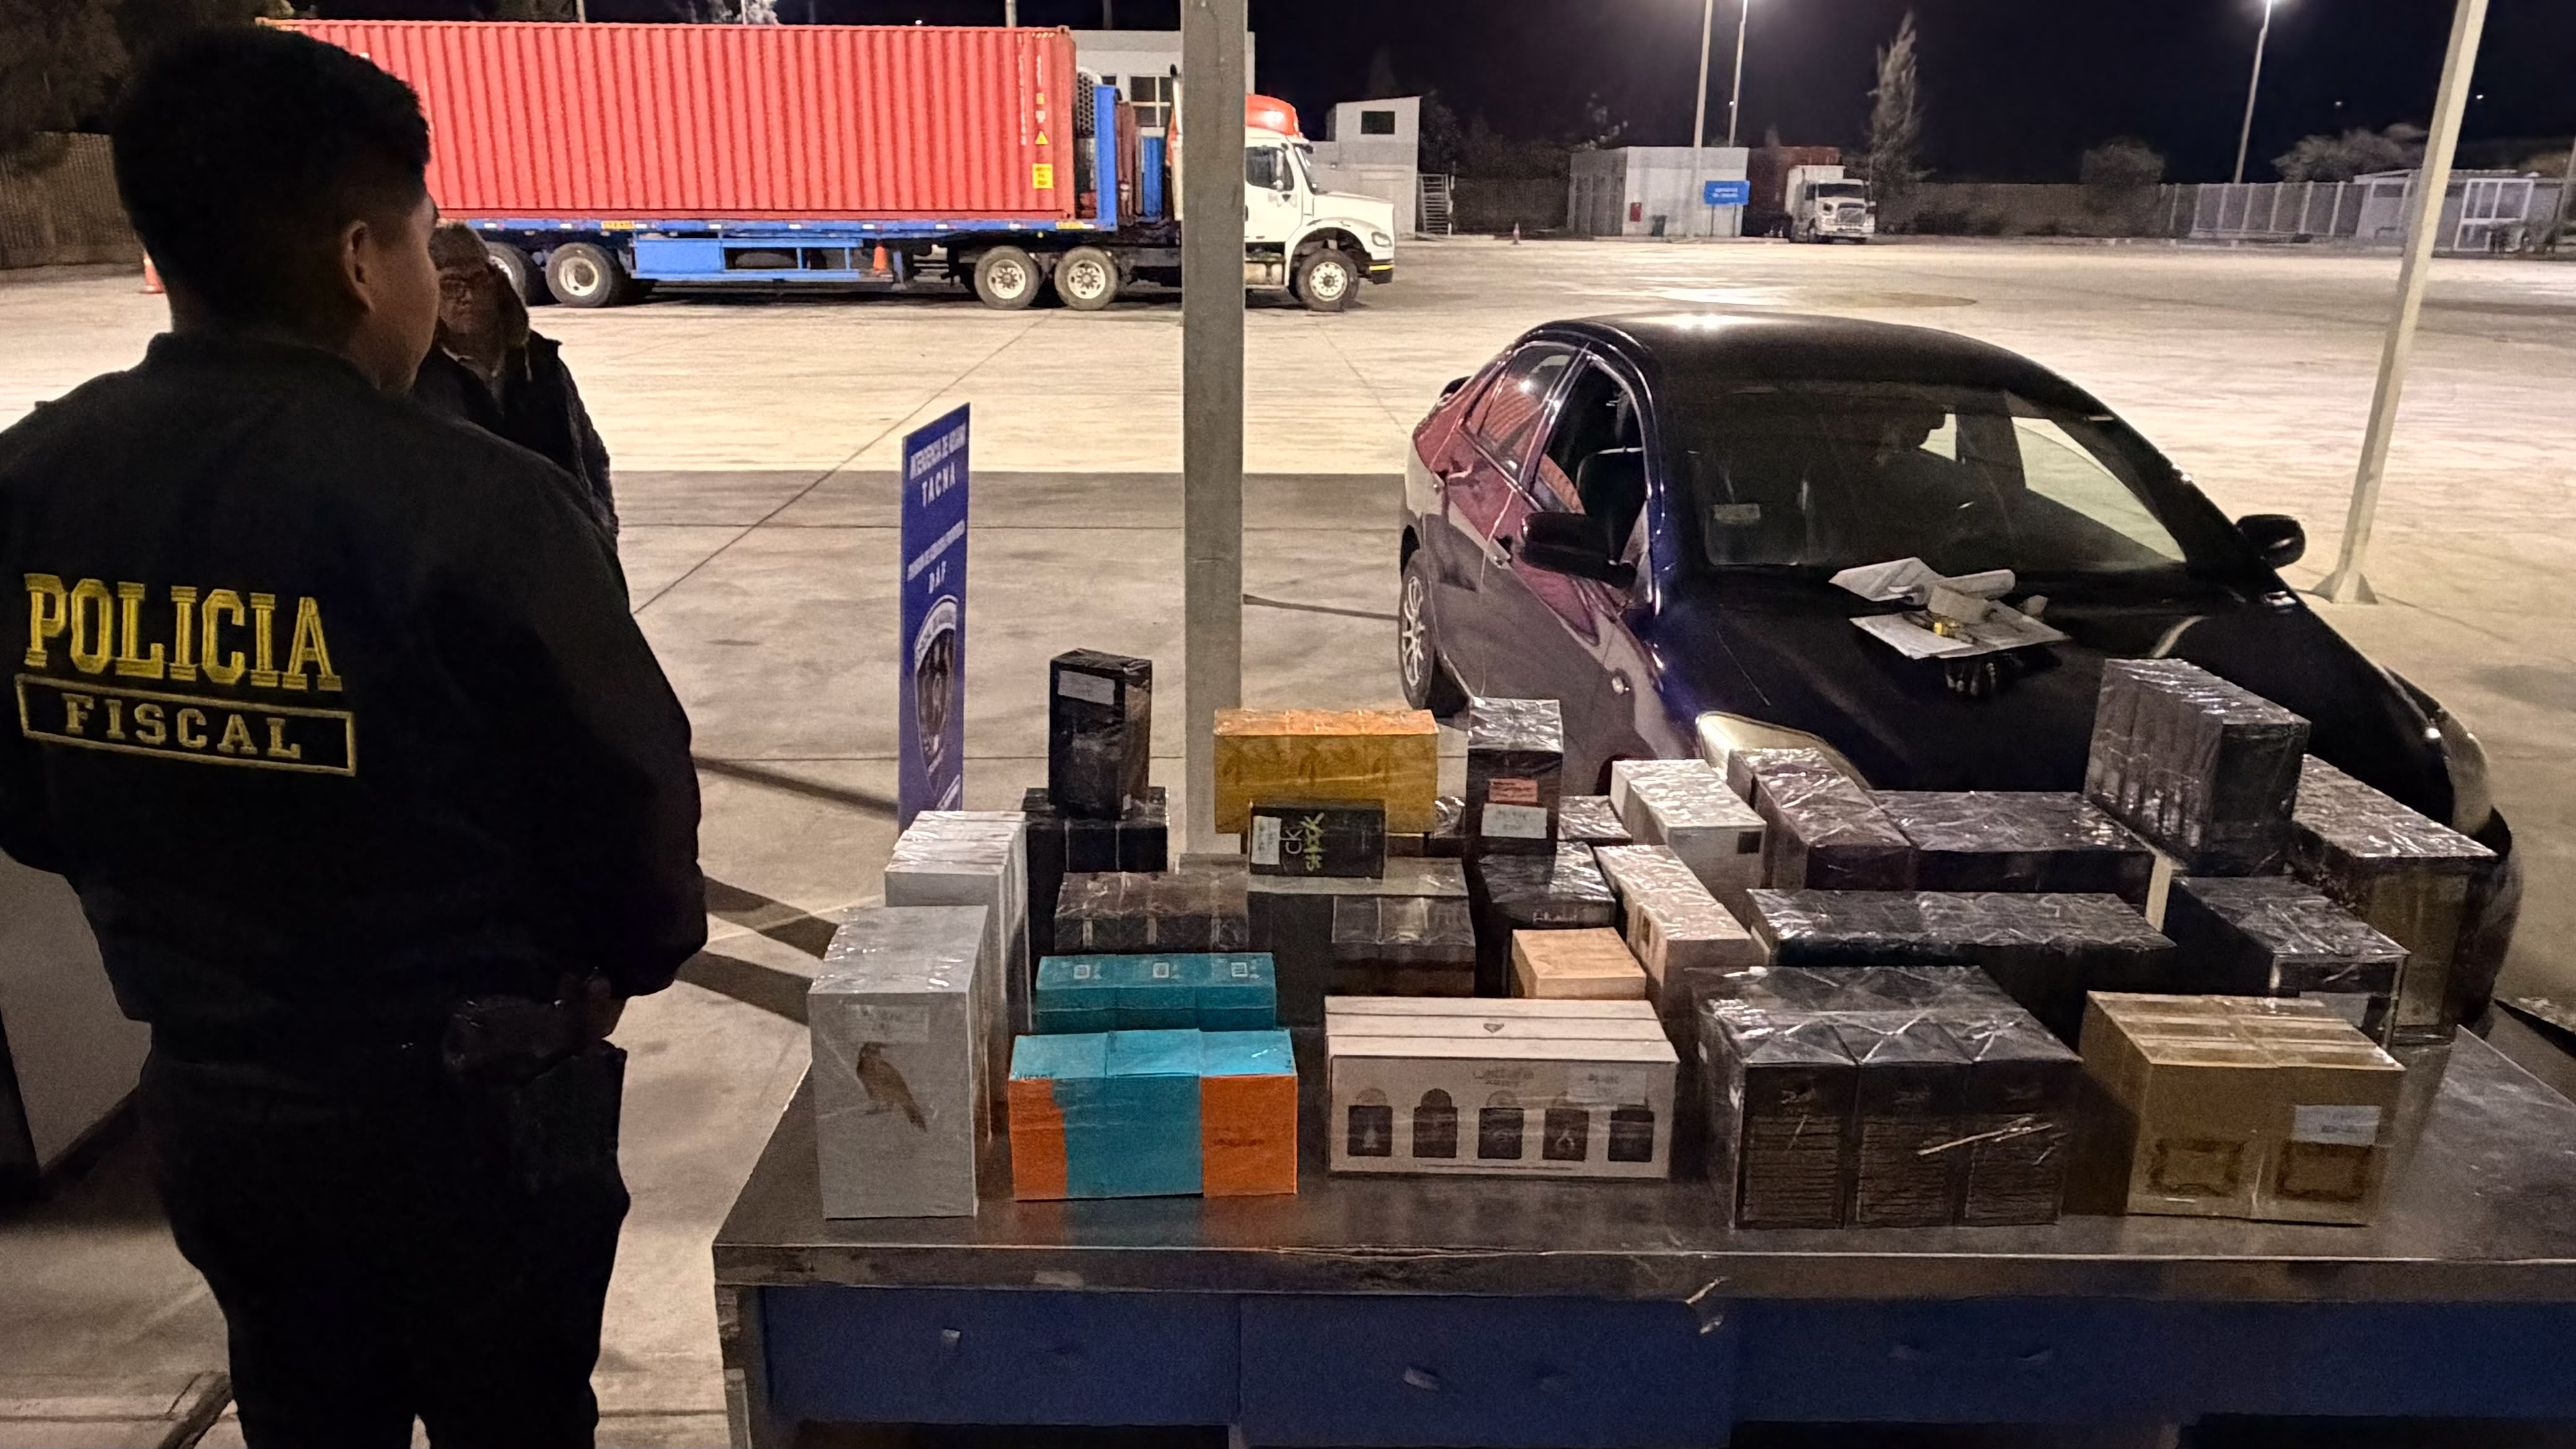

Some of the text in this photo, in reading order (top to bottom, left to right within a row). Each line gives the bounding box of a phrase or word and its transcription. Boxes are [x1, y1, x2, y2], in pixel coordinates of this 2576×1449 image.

[921, 461, 955, 507] TACNA
[24, 573, 342, 692] POLICIA
[63, 692, 302, 759] FISCAL
[1280, 829, 1303, 854] CK
